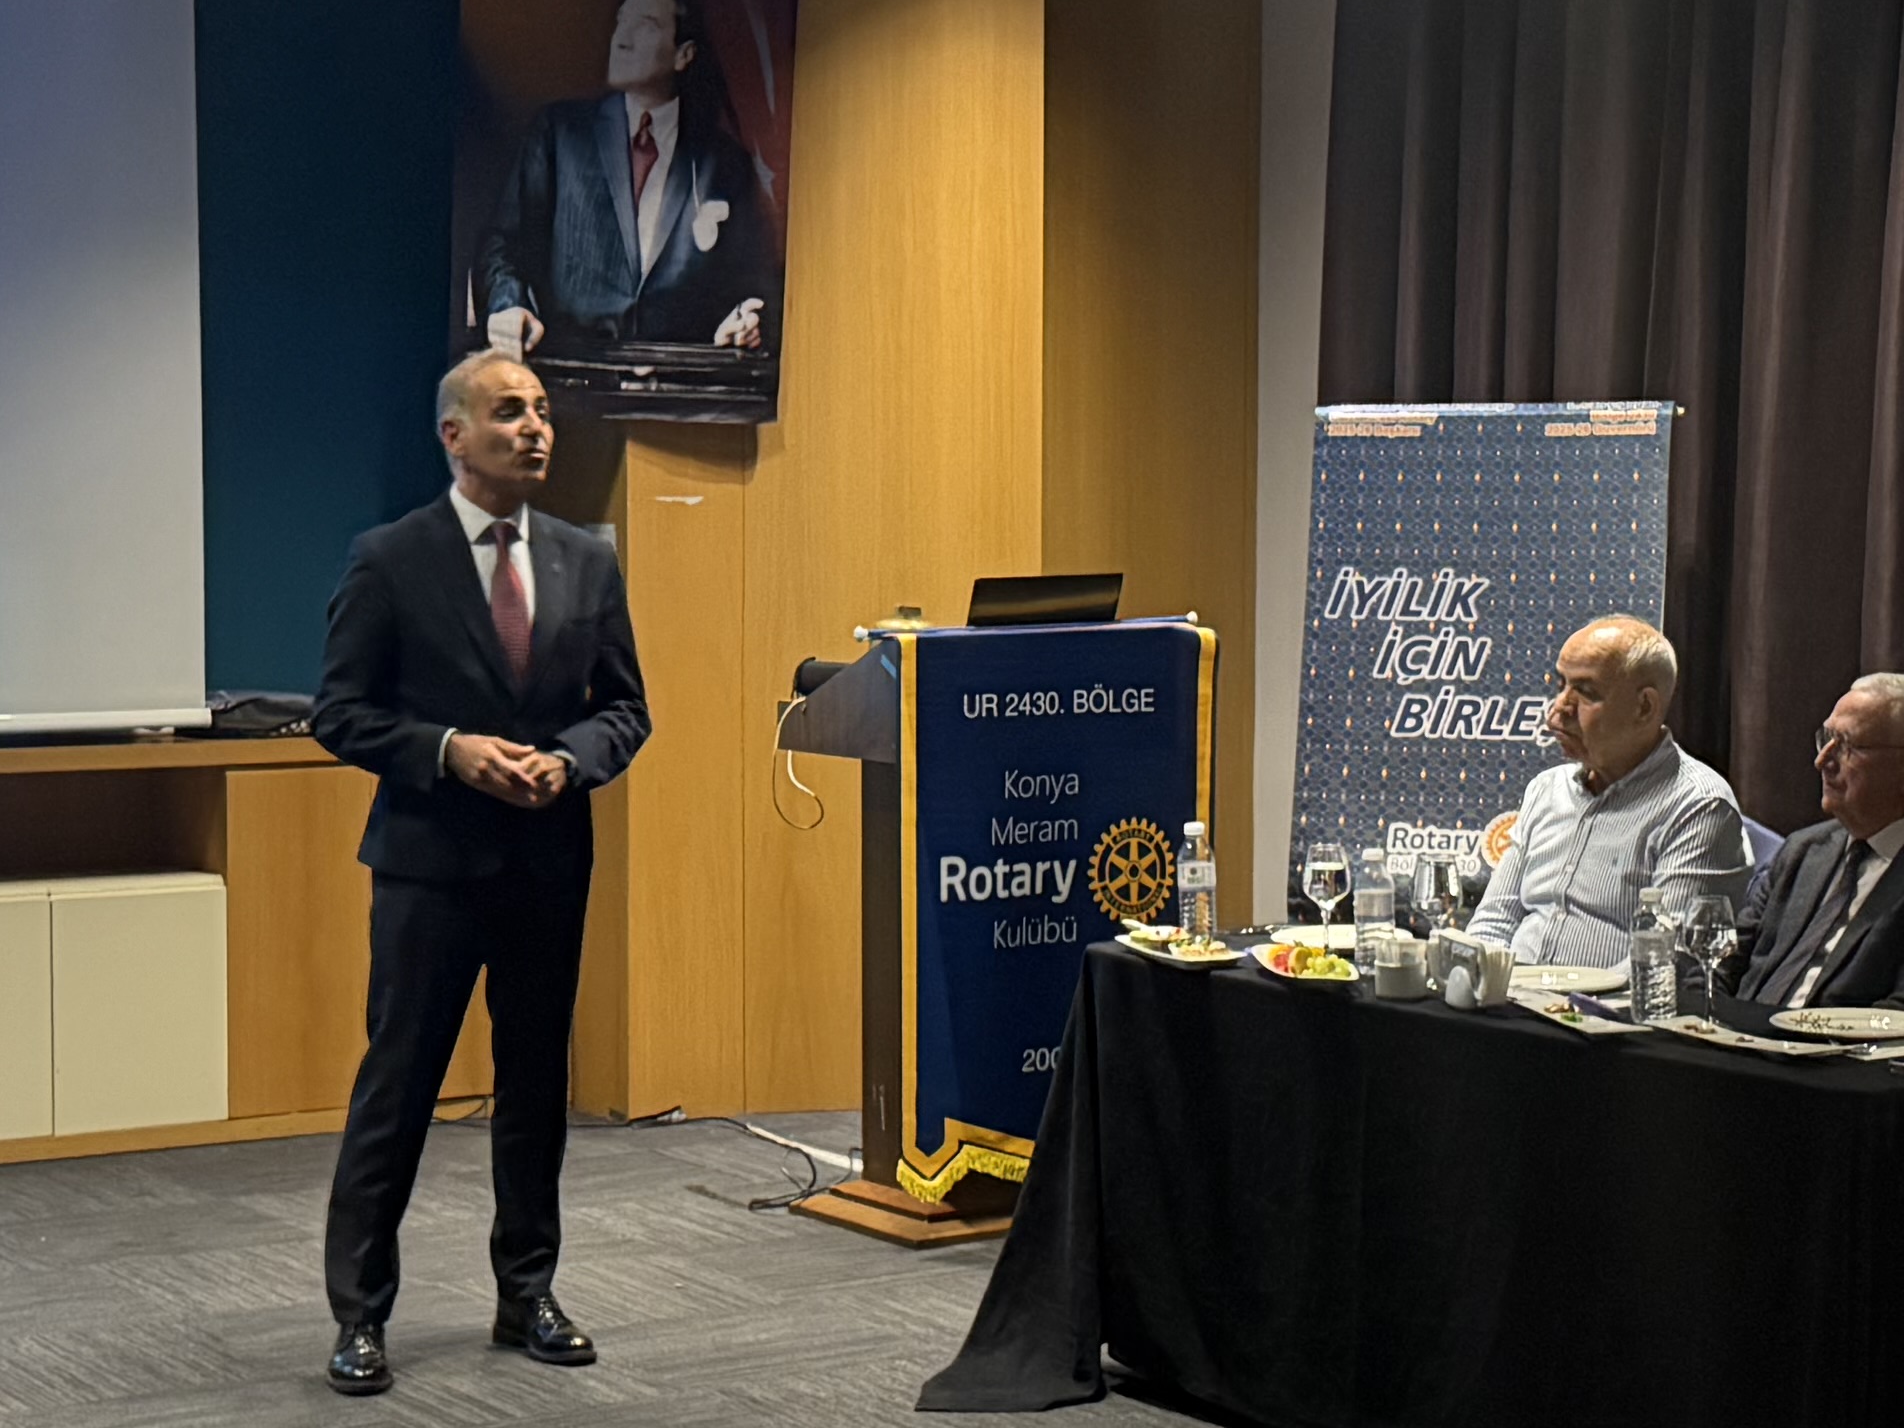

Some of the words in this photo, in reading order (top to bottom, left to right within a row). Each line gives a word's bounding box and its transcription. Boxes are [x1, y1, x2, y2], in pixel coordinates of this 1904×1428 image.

[1324, 567, 1490, 622] İYİLİK
[1372, 626, 1493, 685] İÇİN
[963, 693, 998, 718] UR
[1004, 691, 1065, 717] 2430.
[1073, 683, 1155, 714] BÖLGE
[1004, 769, 1080, 805] Konya
[991, 815, 1079, 847] Meram
[1391, 826, 1480, 856] Rotary
[939, 855, 1078, 904] Rotary
[993, 913, 1078, 949] Kulübü
